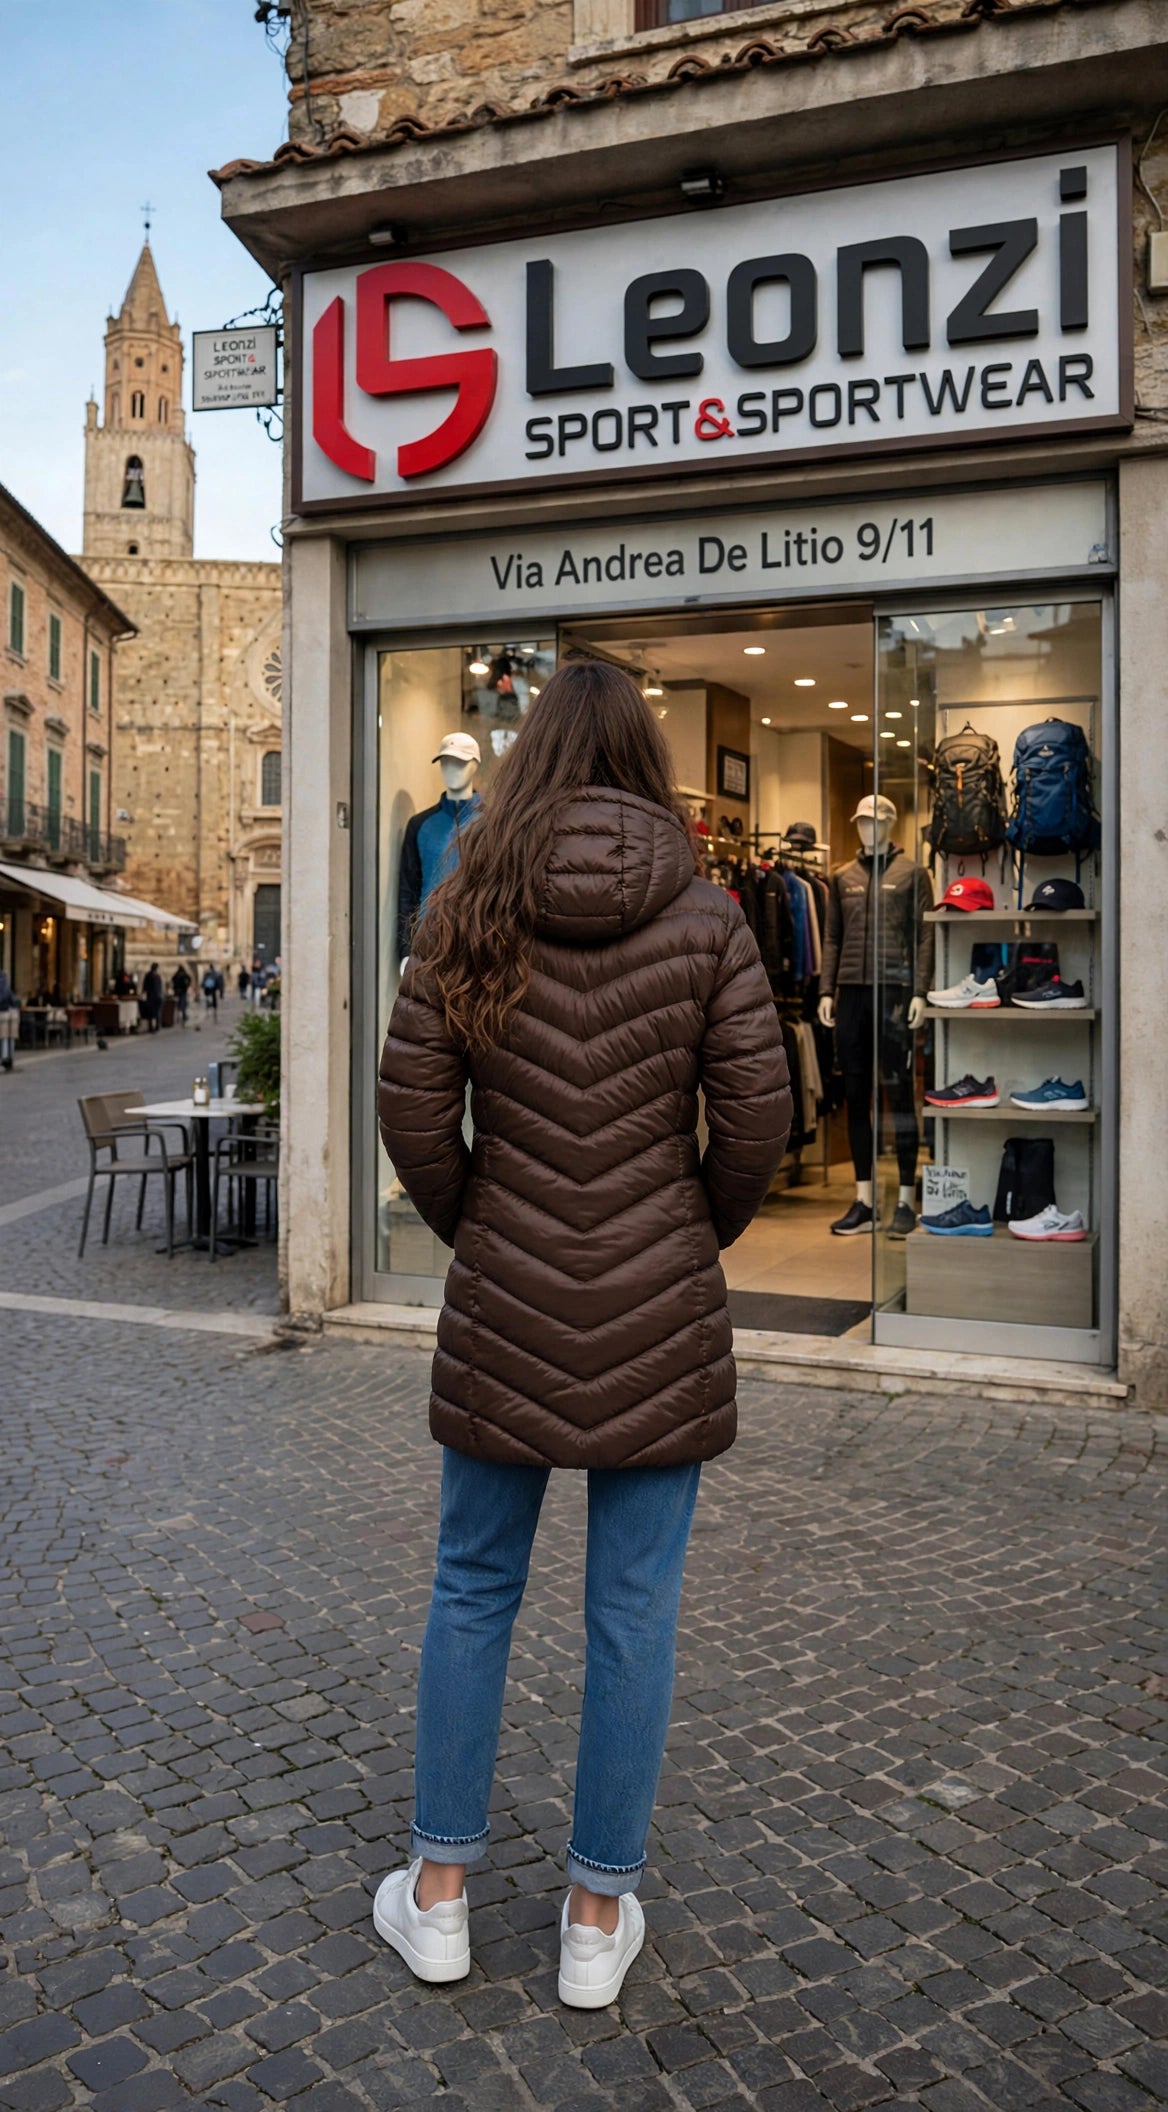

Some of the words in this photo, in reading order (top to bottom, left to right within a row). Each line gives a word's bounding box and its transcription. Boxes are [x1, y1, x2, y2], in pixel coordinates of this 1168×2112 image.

[526, 166, 1089, 402] Leonzi
[490, 554, 544, 590] Via
[554, 544, 685, 586] Andrea
[699, 536, 748, 574] De
[761, 527, 844, 570] Litio
[857, 517, 934, 563] 9/11
